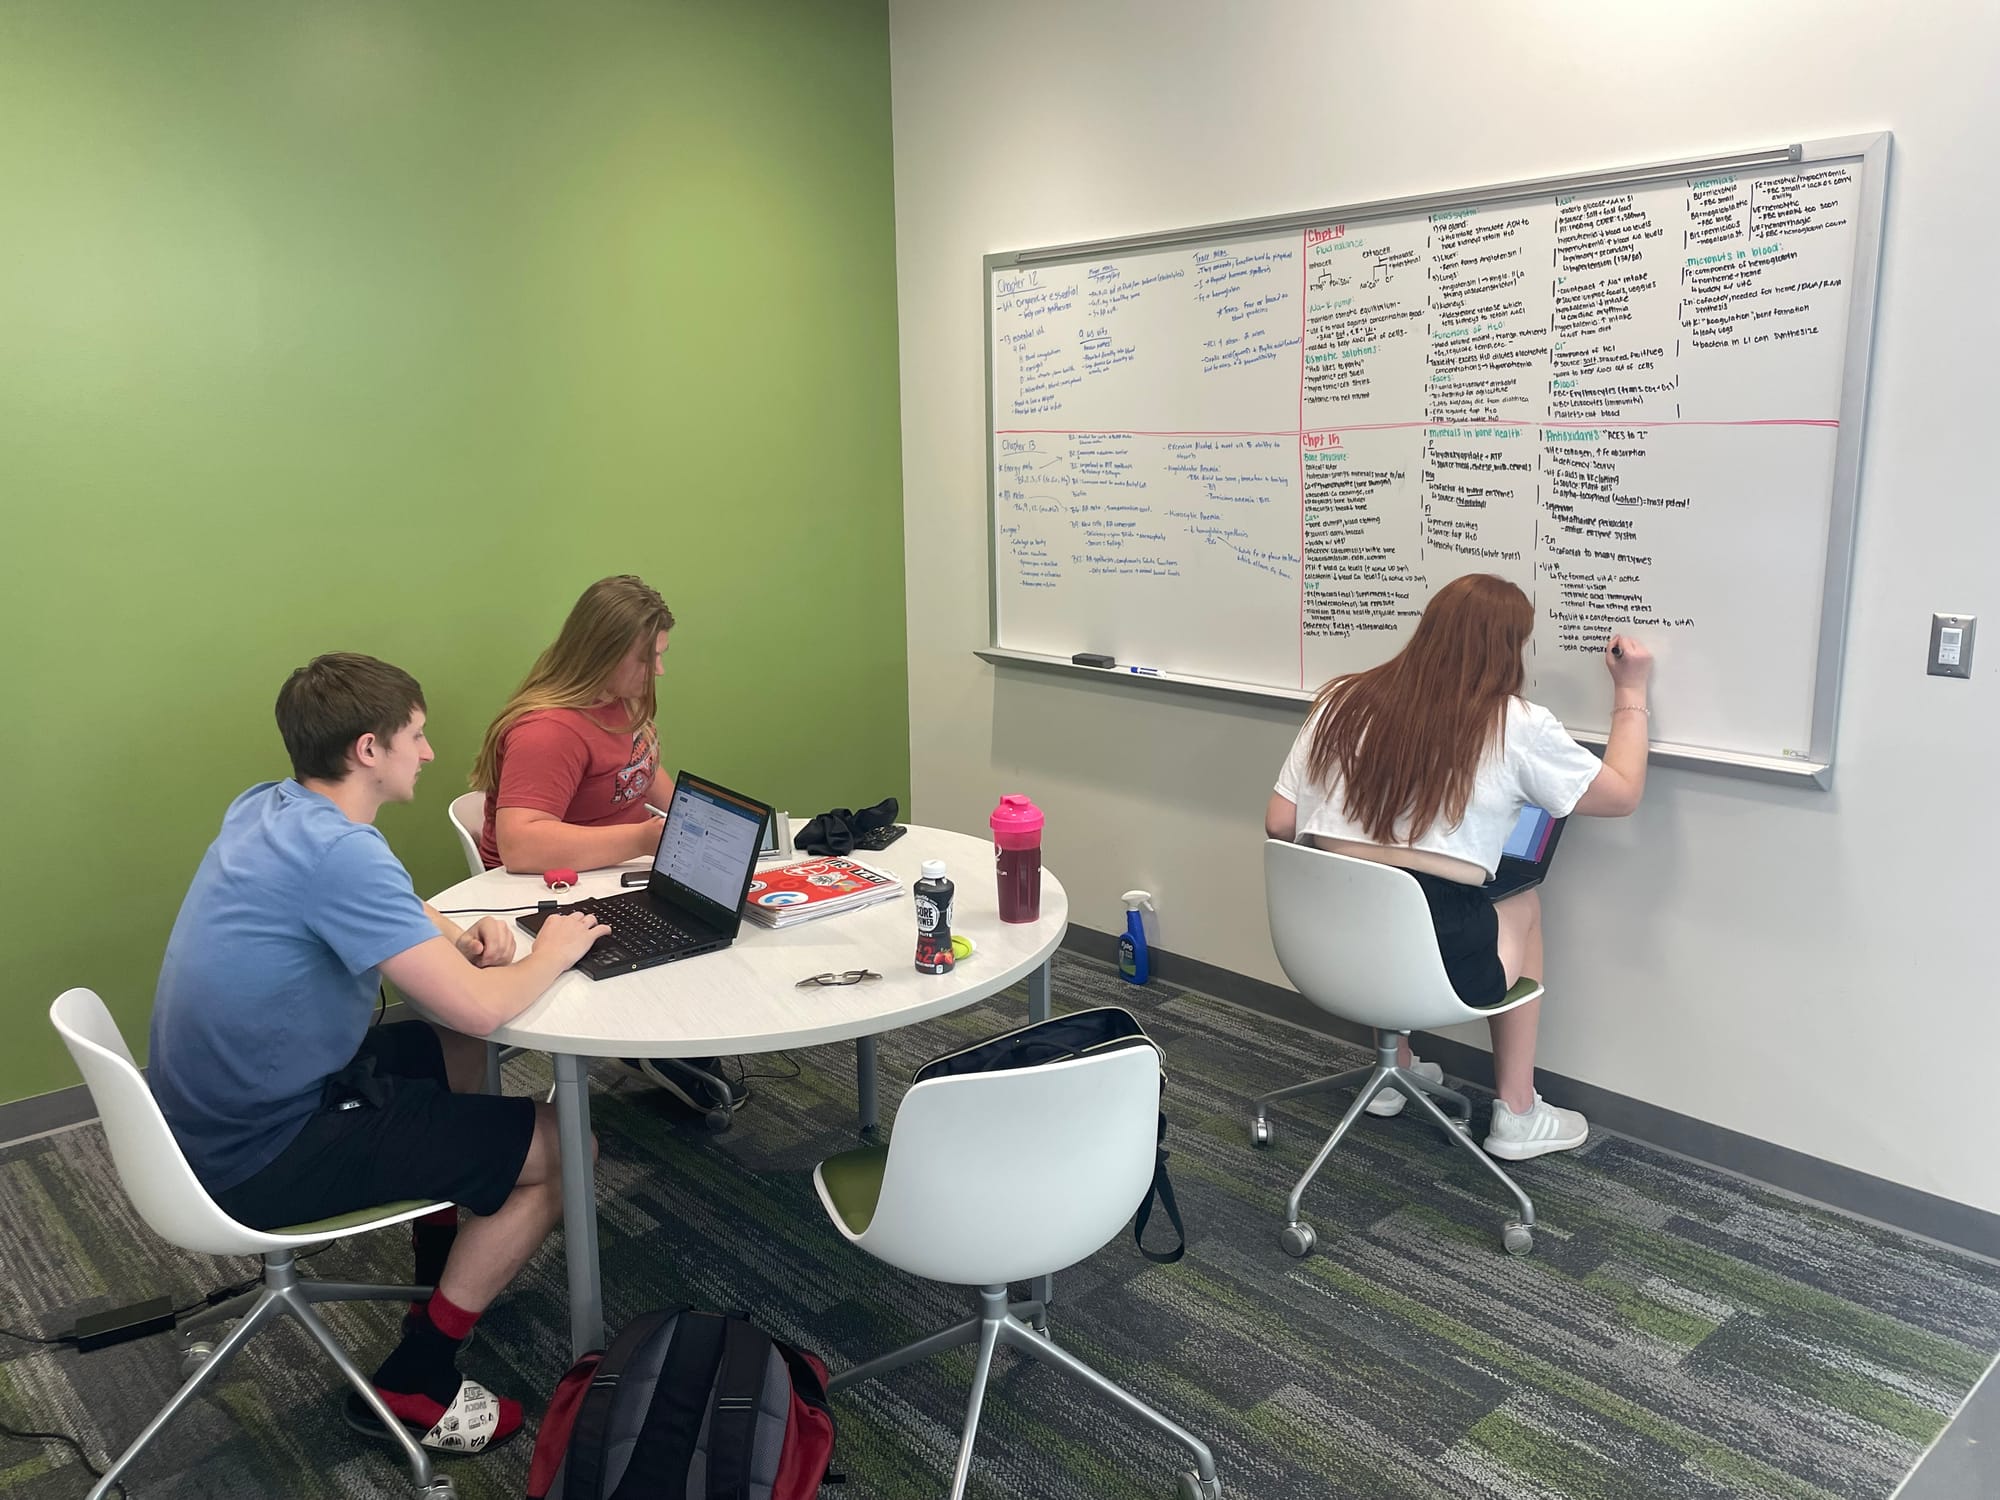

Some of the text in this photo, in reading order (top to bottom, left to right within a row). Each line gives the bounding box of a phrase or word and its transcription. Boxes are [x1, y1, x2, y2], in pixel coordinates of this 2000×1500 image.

[1736, 250, 1746, 262] in
[1738, 260, 1746, 269] of
[1584, 548, 1592, 558] to
[1663, 618, 1671, 627] to
